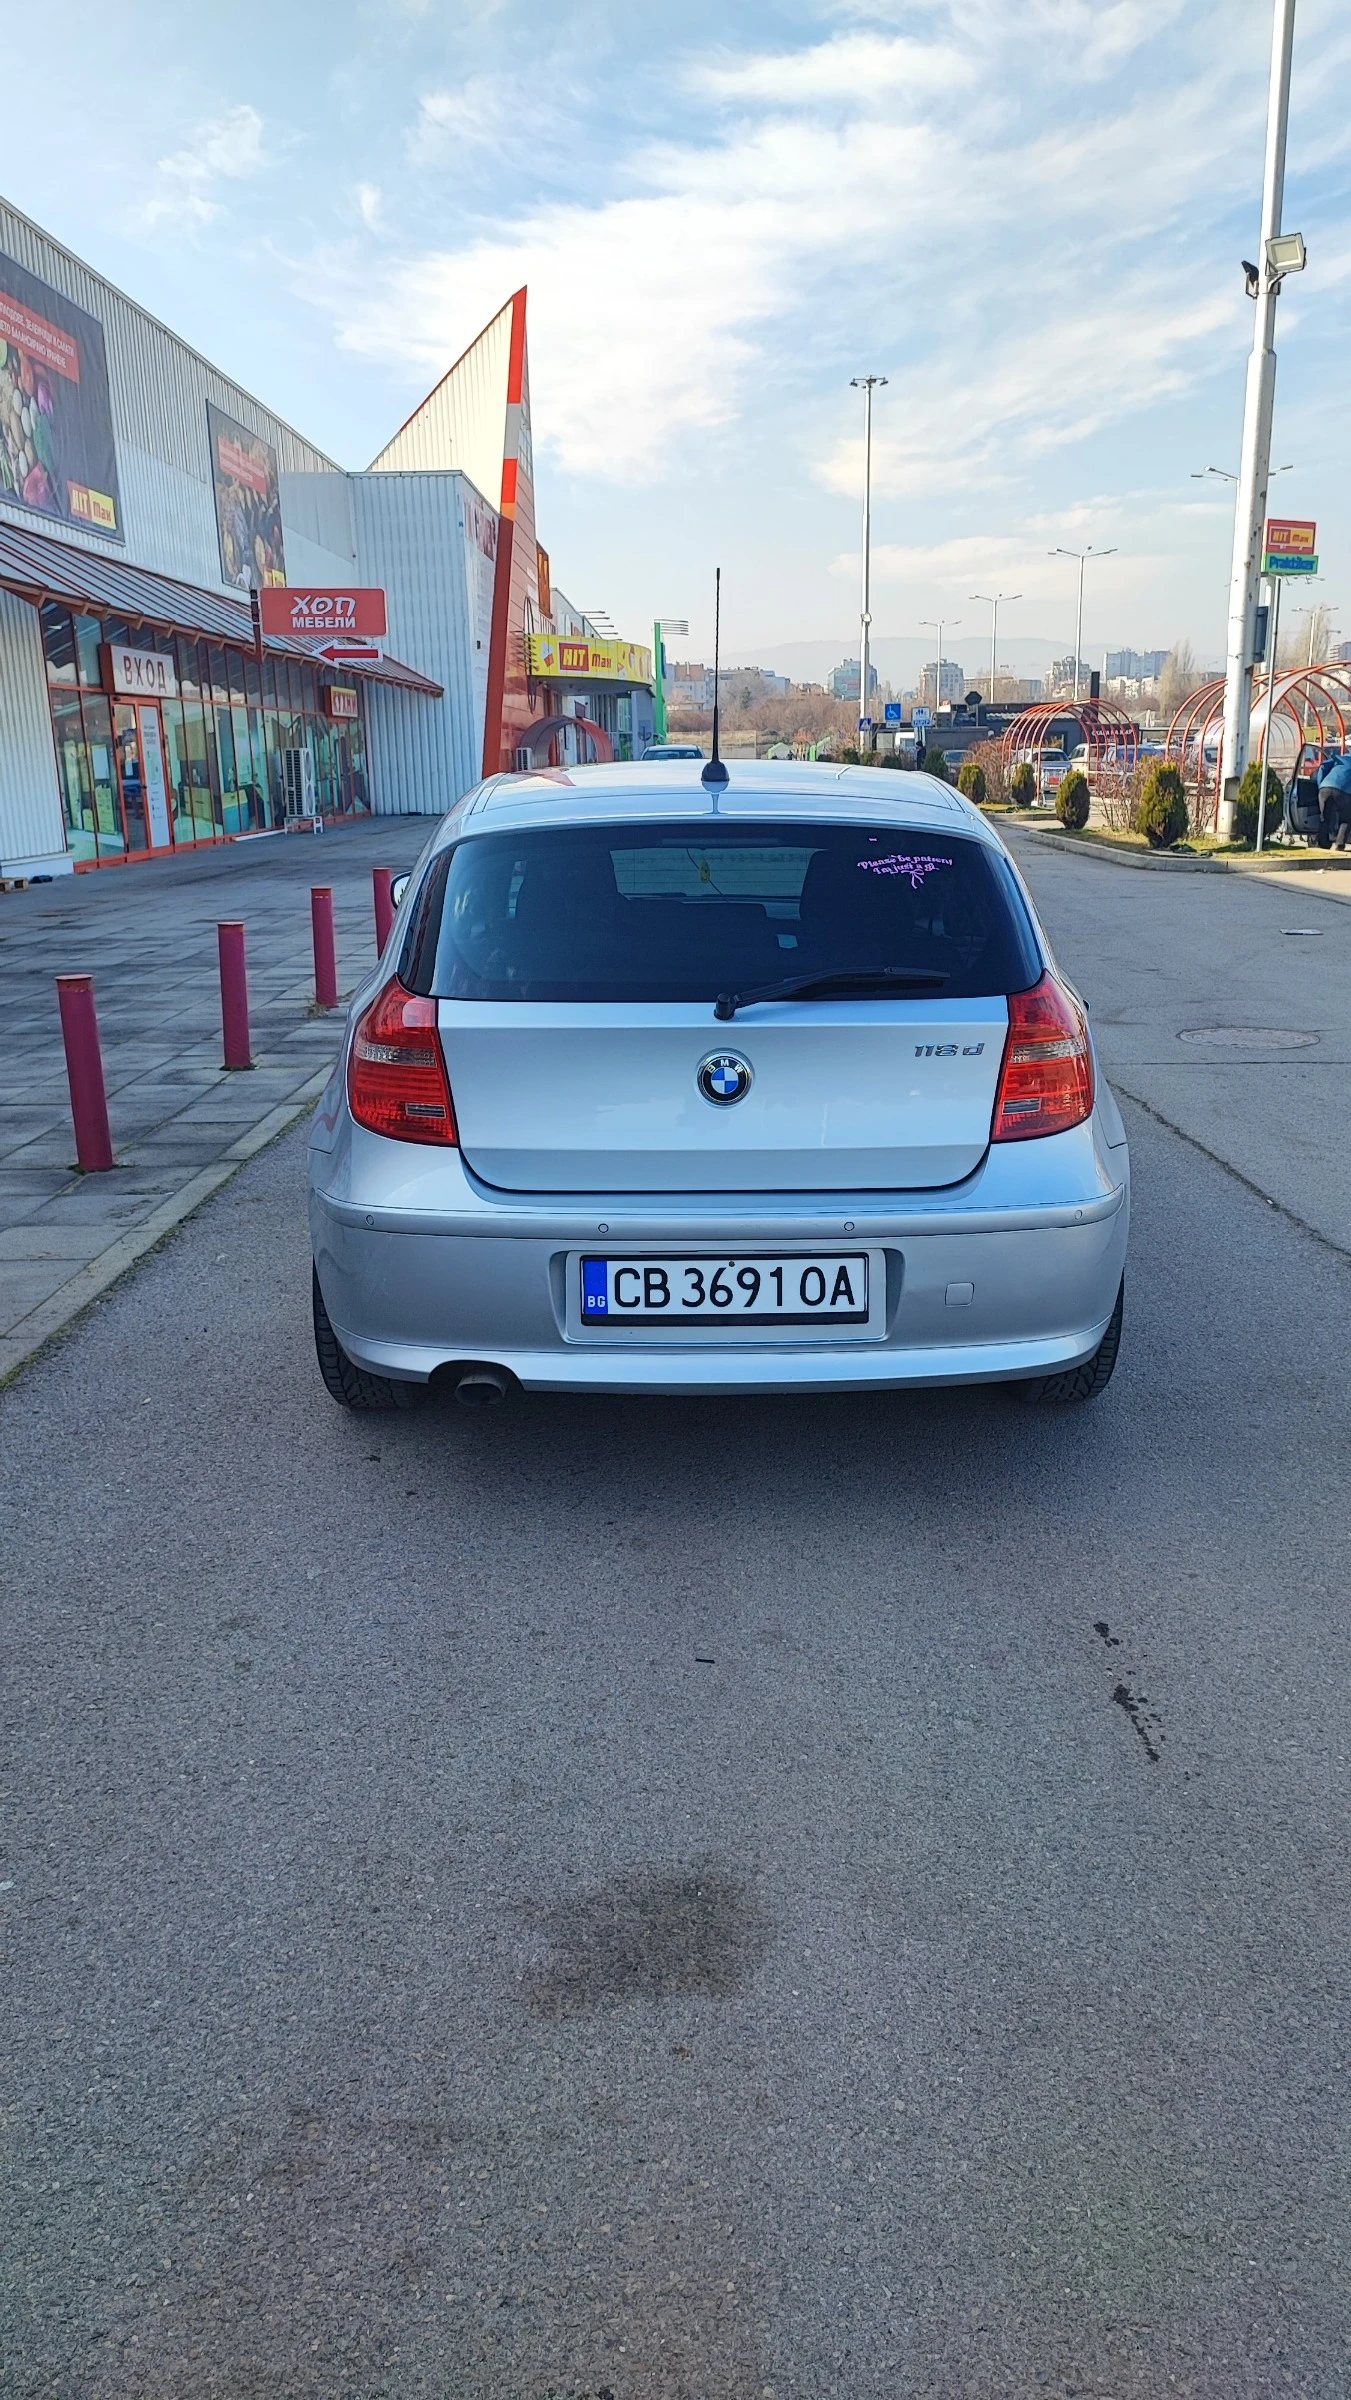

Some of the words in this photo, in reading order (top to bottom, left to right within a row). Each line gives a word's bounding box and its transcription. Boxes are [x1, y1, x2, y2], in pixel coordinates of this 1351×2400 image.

[72, 489, 88, 514] HIT
[1272, 530, 1289, 542] HIT
[290, 595, 356, 617] ХОП
[292, 616, 356, 629] МЕБЕЛИ
[563, 648, 586, 667] HIT
[123, 654, 168, 694] ВХОД
[857, 857, 896, 870] Please
[897, 854, 911, 862] be
[706, 1059, 744, 1073] BMW
[587, 1295, 606, 1308] BG
[613, 1267, 671, 1308] CB
[681, 1266, 783, 1308] 3691
